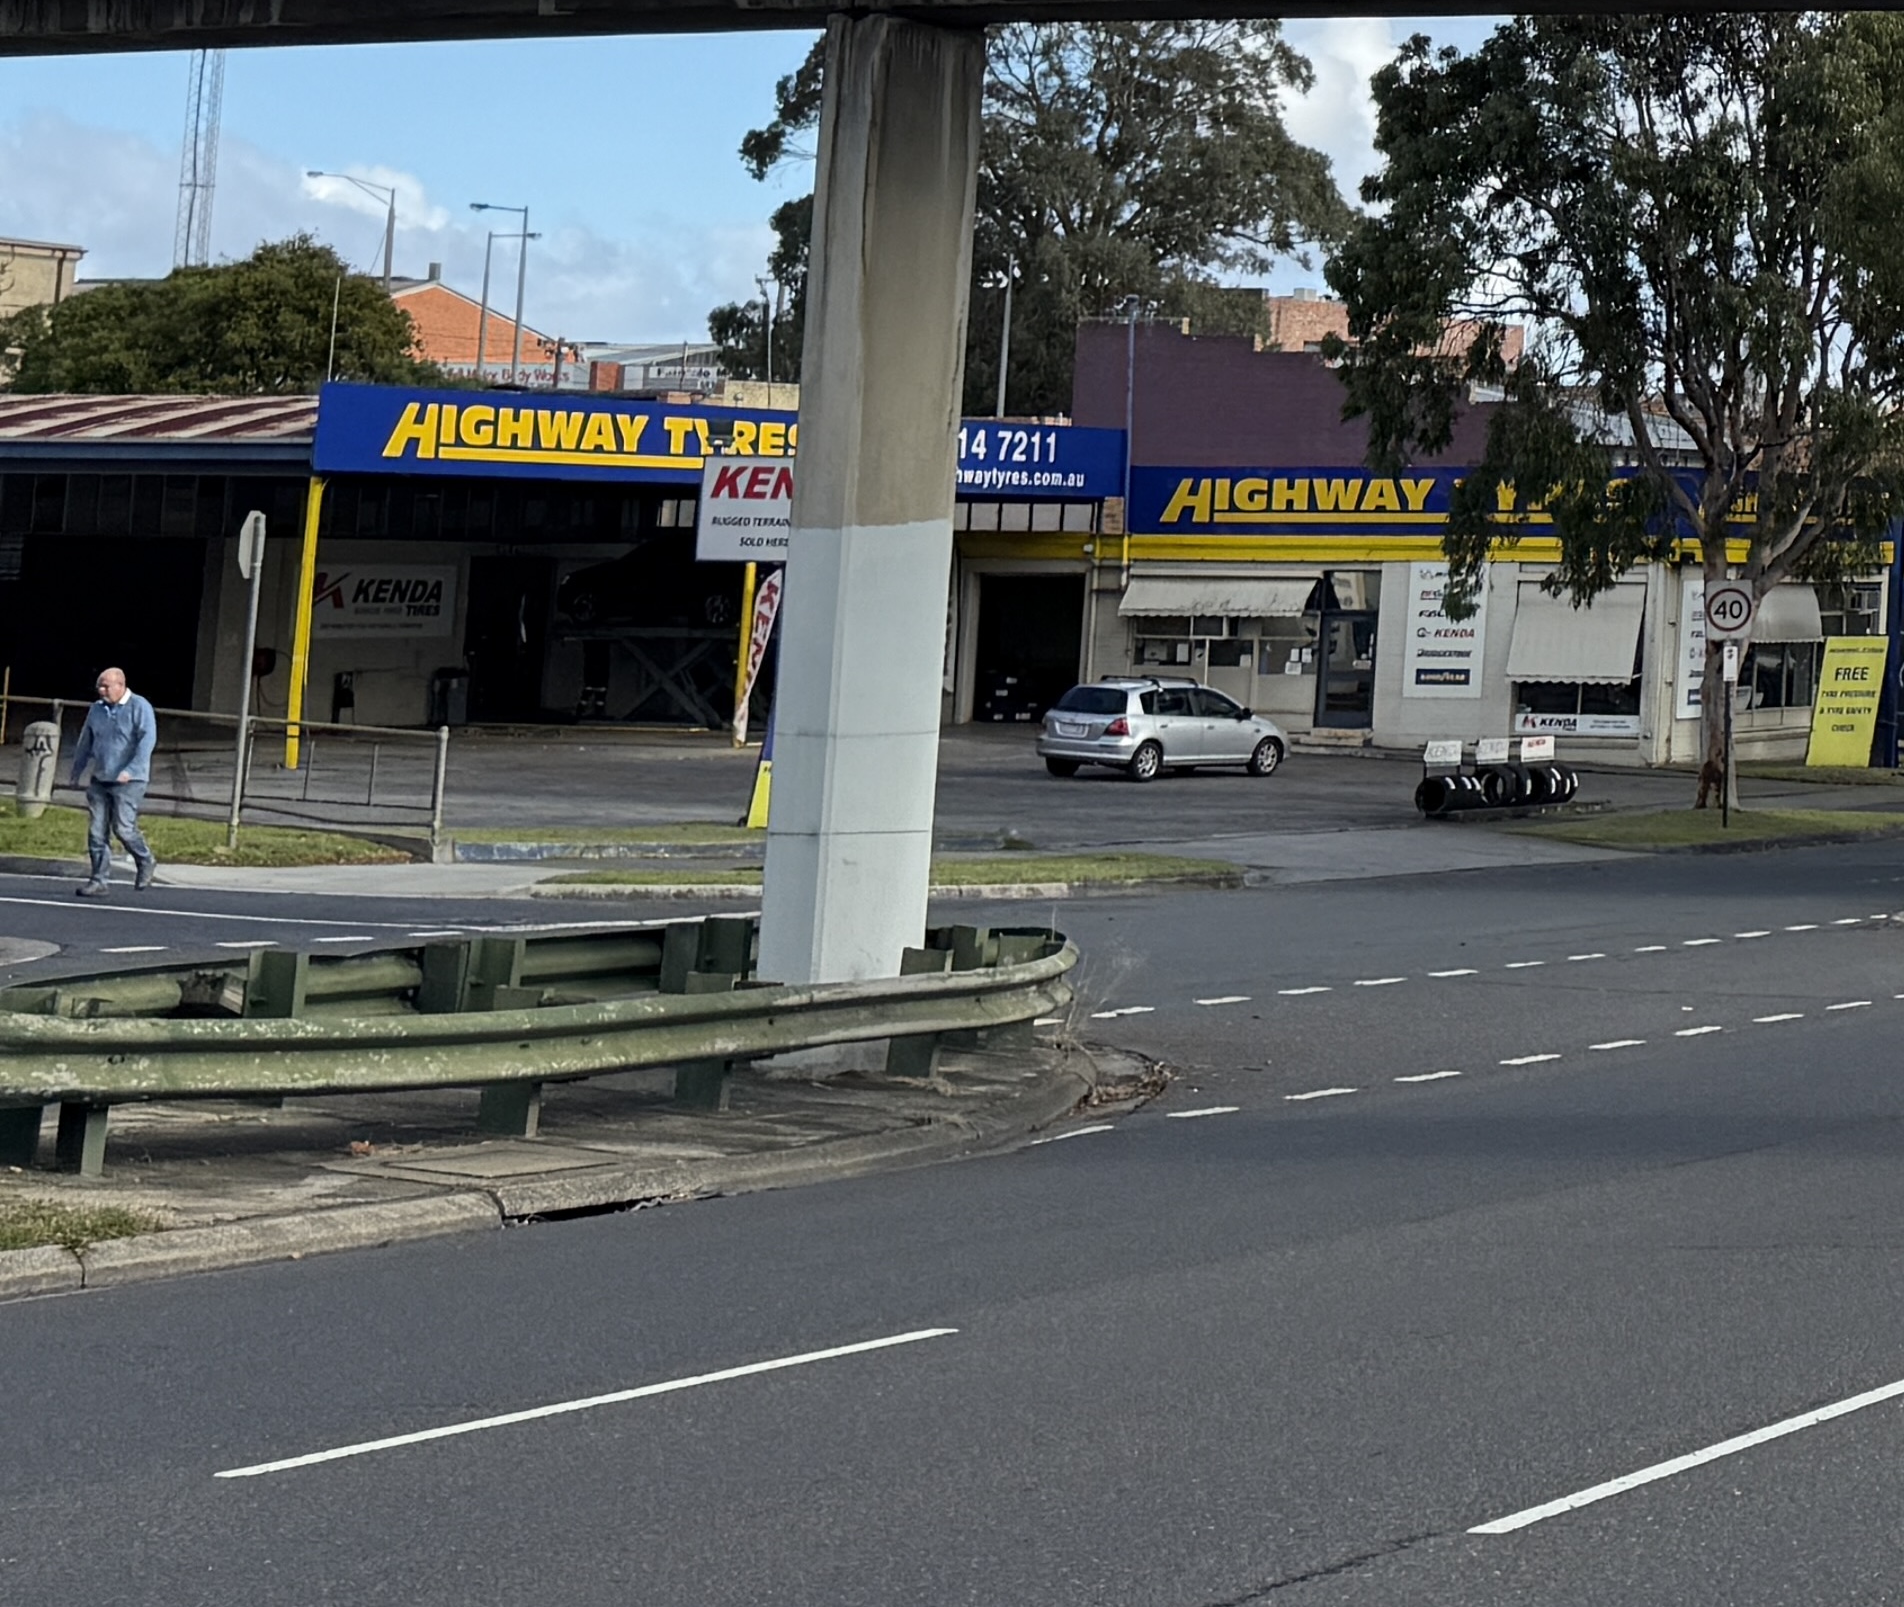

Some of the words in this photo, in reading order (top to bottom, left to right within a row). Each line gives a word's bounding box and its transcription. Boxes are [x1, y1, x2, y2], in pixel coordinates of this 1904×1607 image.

[382, 402, 649, 459] HIGHWAY
[998, 430, 1057, 463] 7211
[1159, 477, 1436, 523] HIGHWAY
[352, 578, 443, 603] KENDA
[1713, 600, 1743, 620] 40
[1834, 666, 1870, 682] FREE
